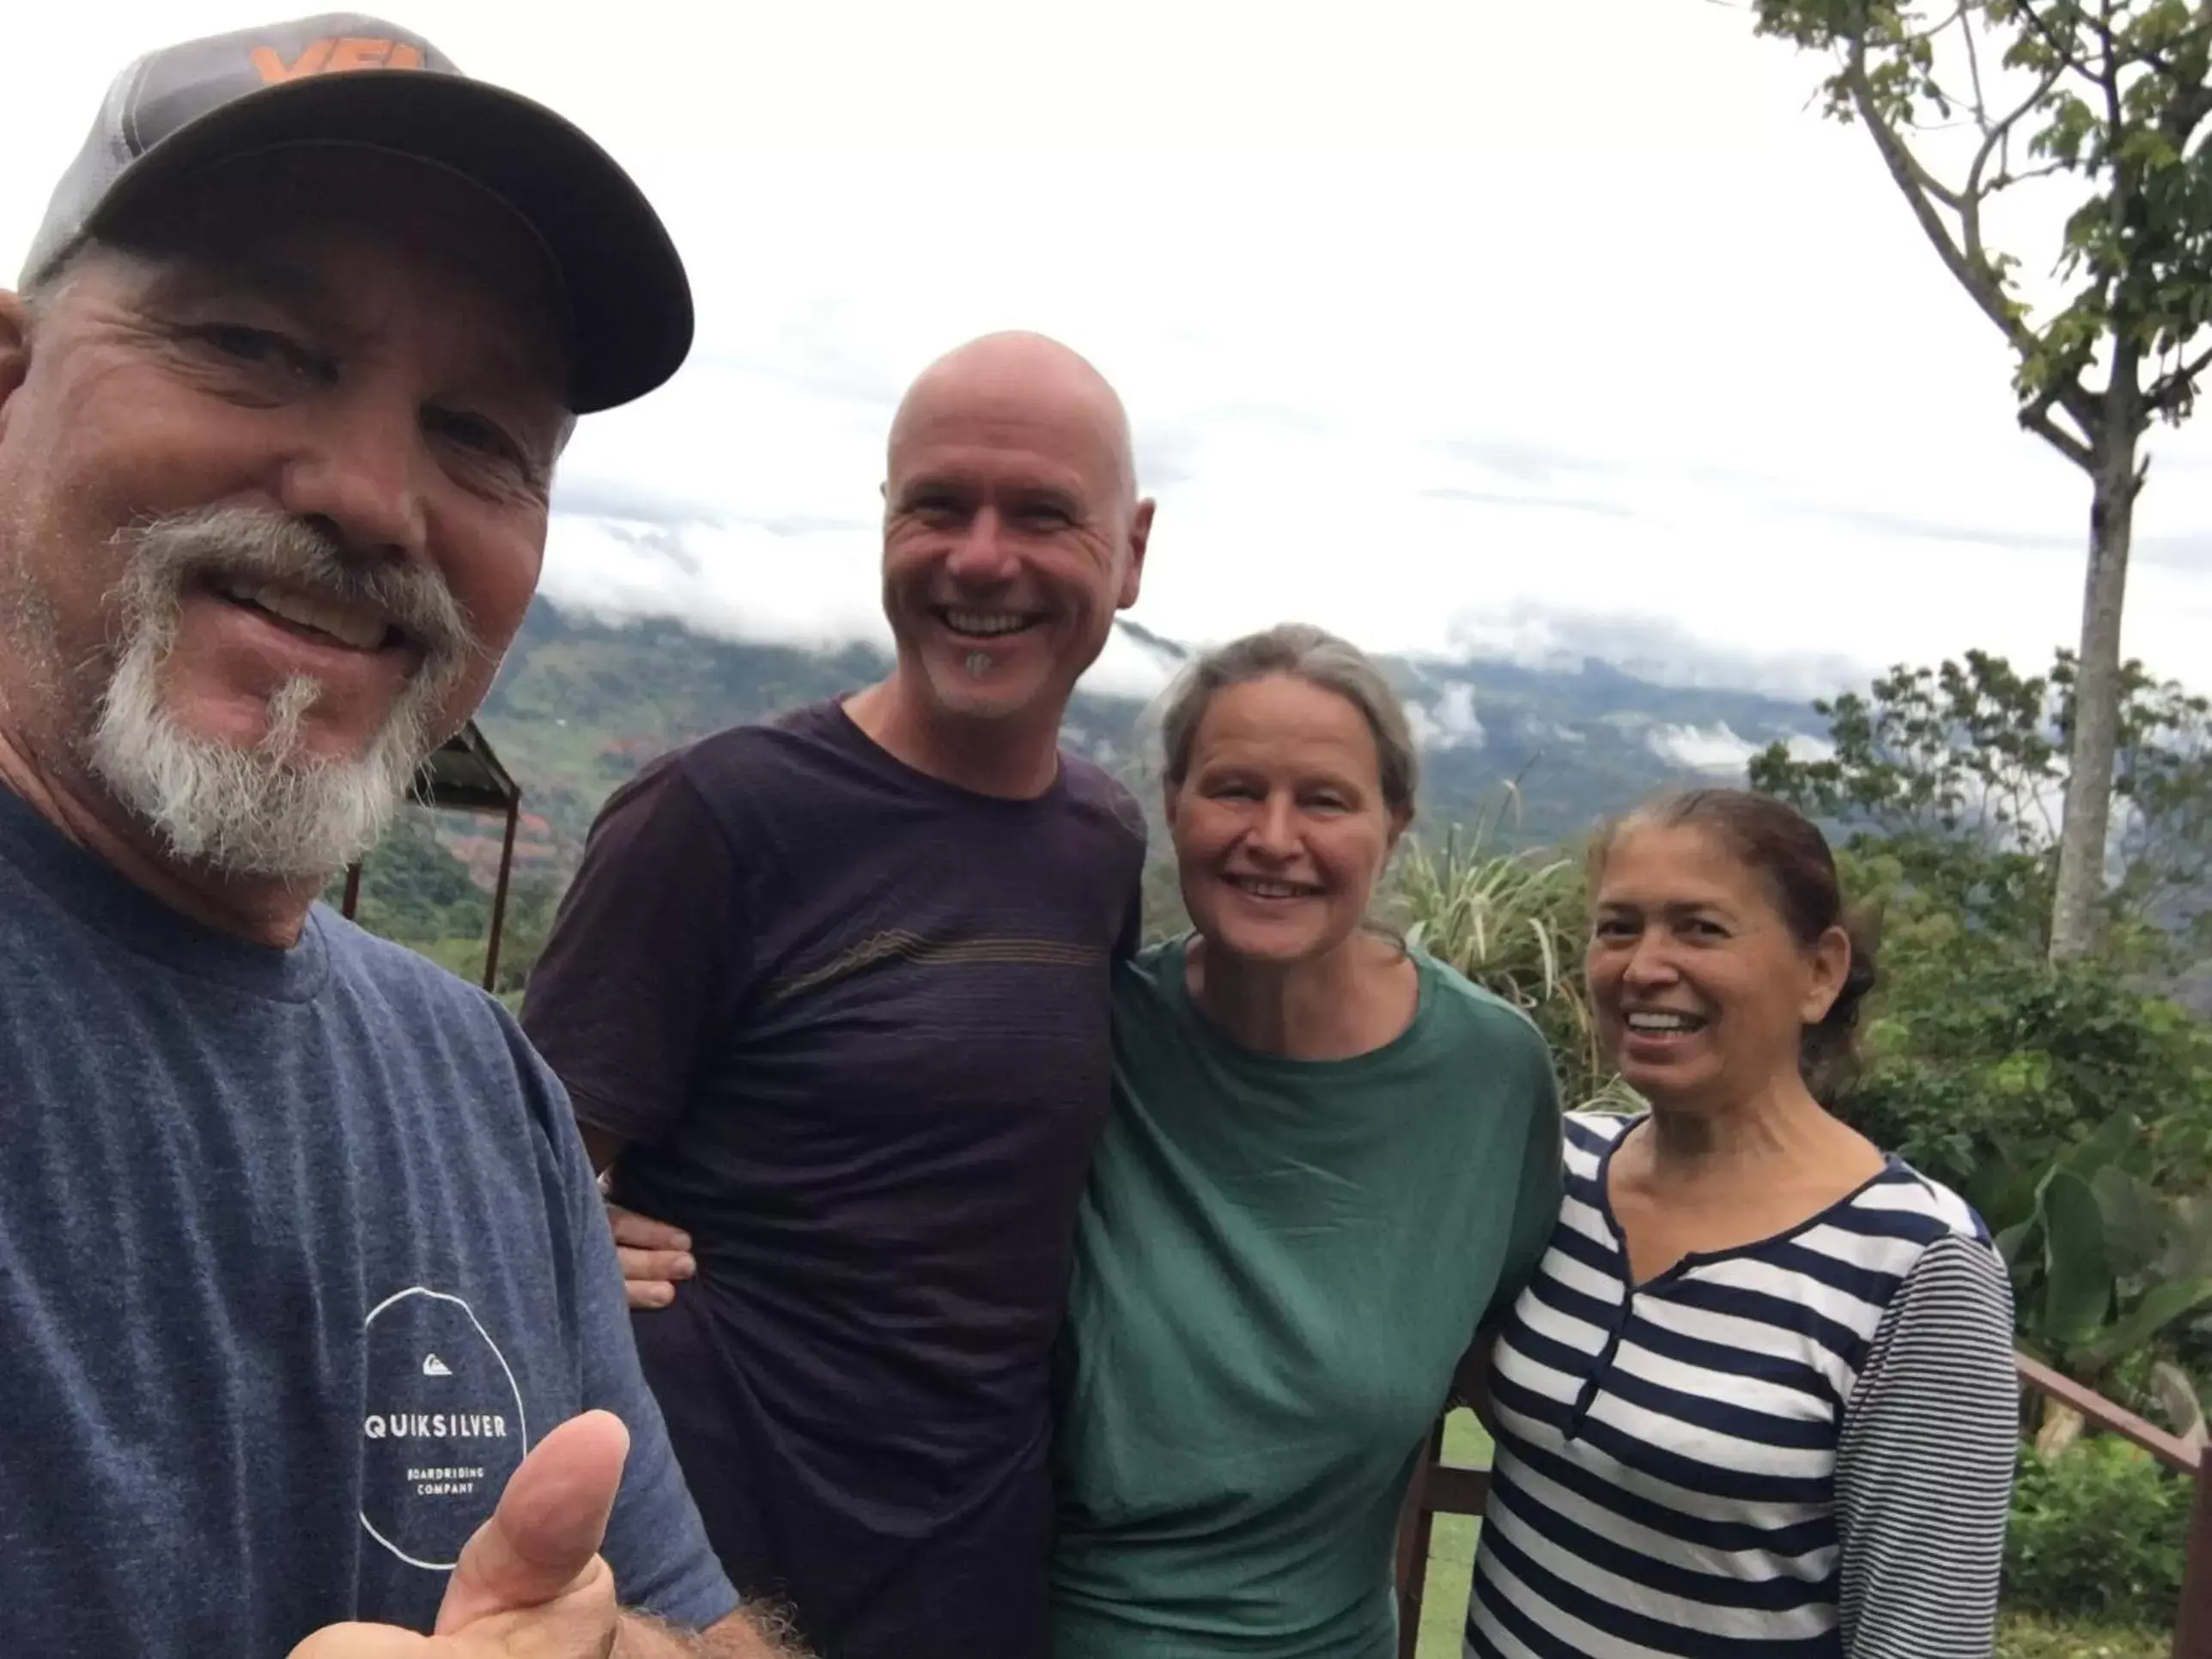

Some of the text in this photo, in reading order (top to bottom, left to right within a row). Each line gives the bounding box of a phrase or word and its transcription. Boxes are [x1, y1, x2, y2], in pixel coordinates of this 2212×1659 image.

[364, 1413, 507, 1439] QUIKSILVER
[407, 1466, 484, 1481] BOARDRIDING
[417, 1483, 474, 1496] COMPANY
